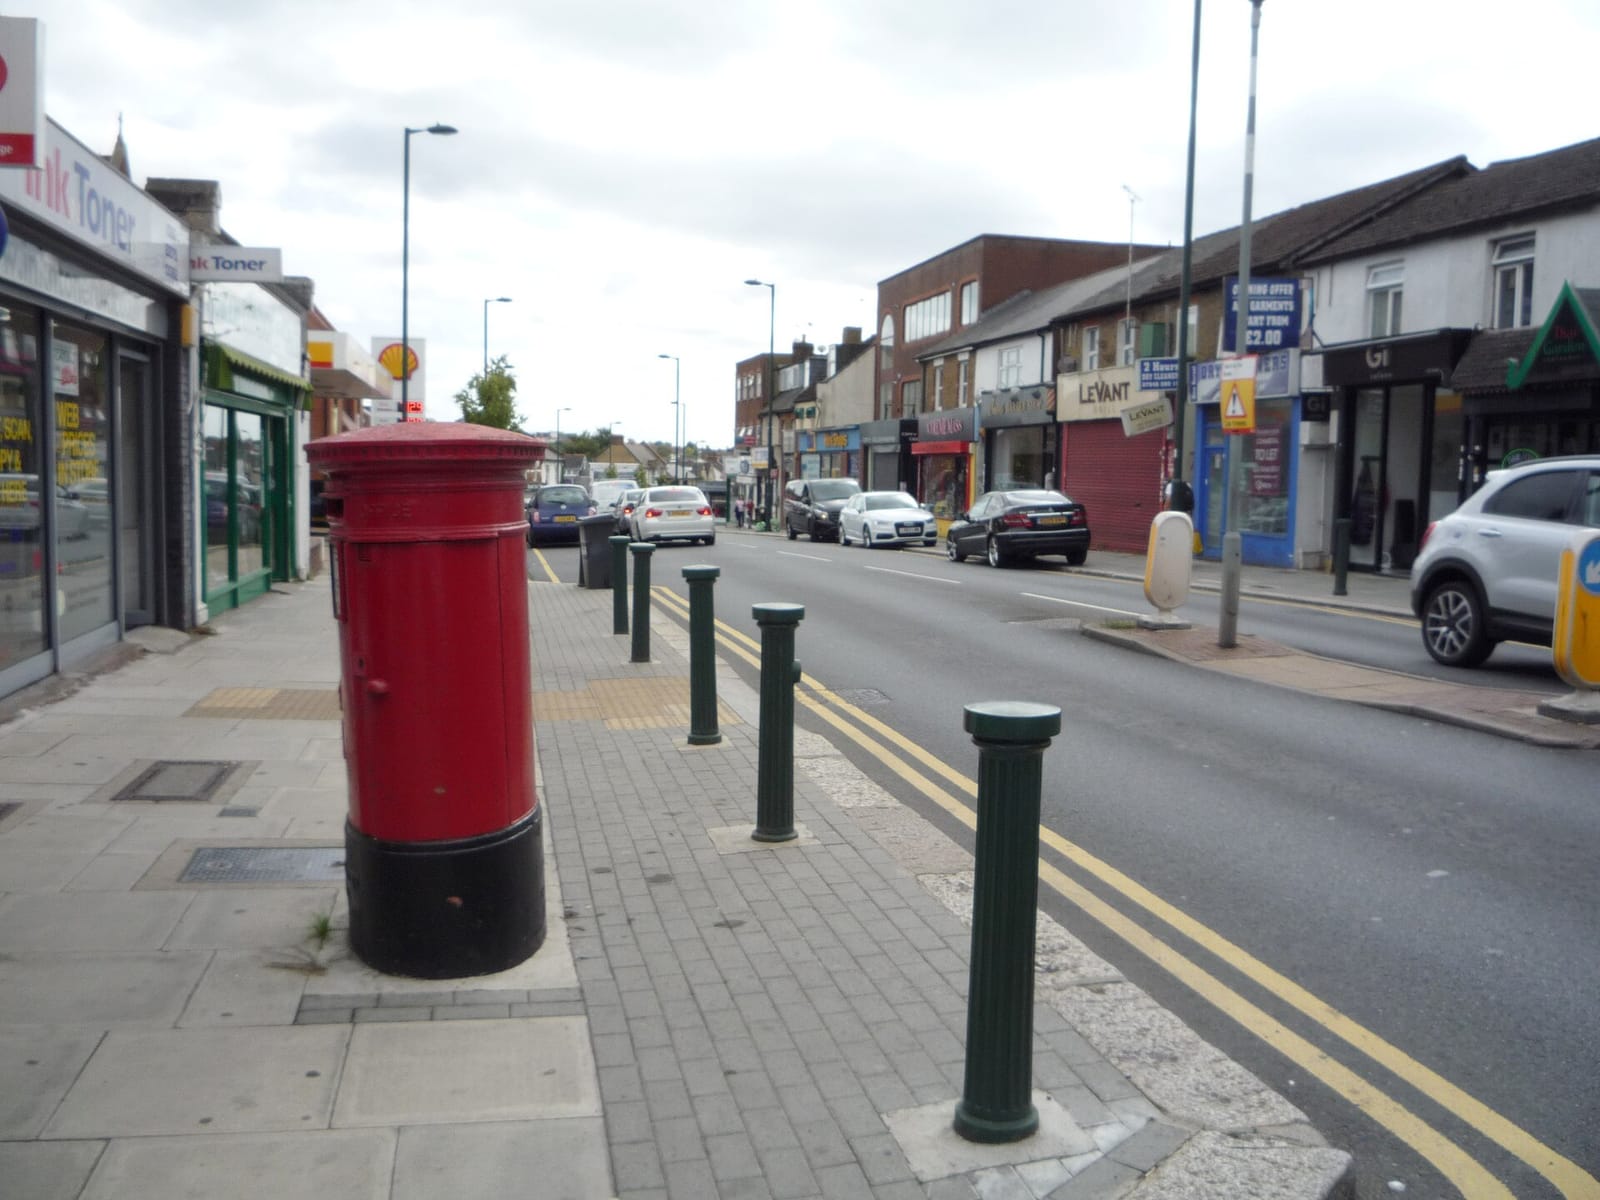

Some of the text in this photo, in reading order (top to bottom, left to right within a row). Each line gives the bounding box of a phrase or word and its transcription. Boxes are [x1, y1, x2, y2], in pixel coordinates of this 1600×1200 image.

[74, 160, 136, 253] Toner
[190, 255, 267, 271] nk Toner
[1232, 283, 1294, 296] ONING OFFER
[1249, 300, 1295, 312] GARMENTS
[1247, 315, 1290, 326] ART FROM
[1245, 329, 1282, 346] £2.00
[1143, 361, 1150, 372] 2
[56, 400, 79, 429] WEB
